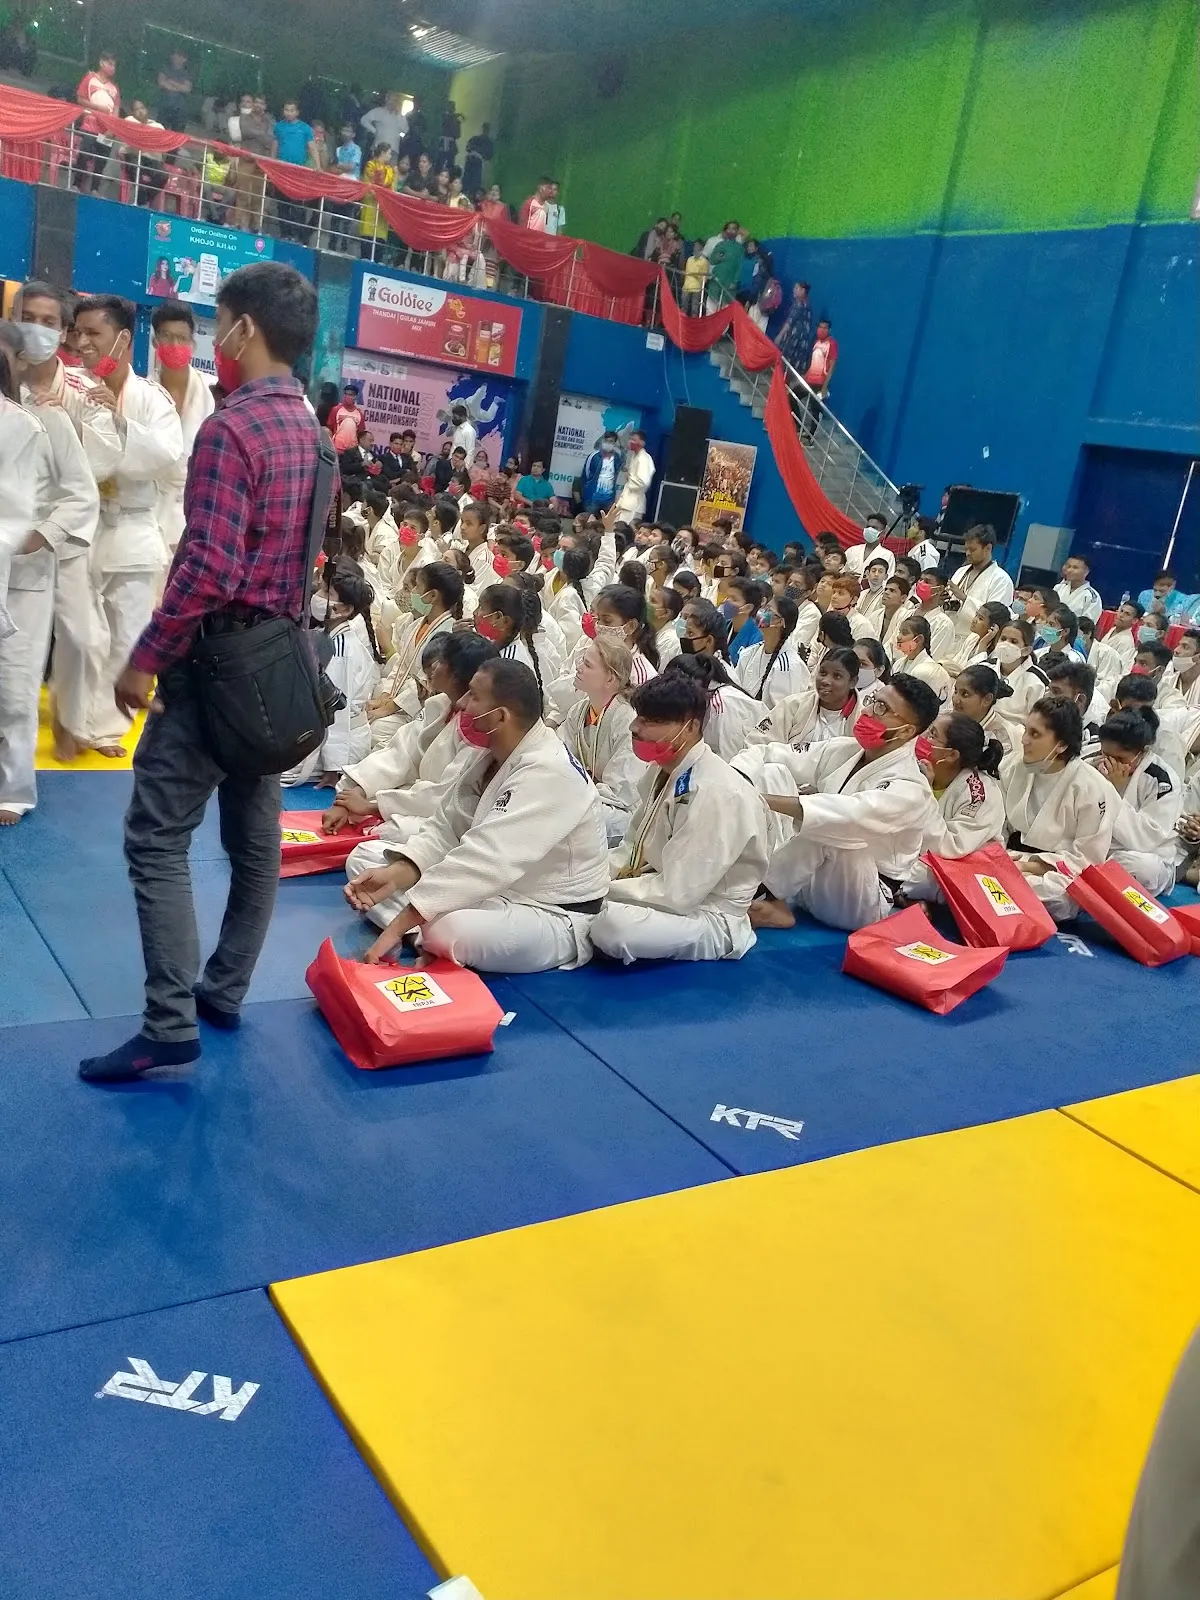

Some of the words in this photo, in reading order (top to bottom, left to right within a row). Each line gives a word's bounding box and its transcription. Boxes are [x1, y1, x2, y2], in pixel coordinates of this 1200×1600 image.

[189, 236, 215, 247] KHOJO
[377, 286, 433, 312] Goldiee
[372, 308, 397, 320] THANDAI
[399, 314, 417, 324] GULAB
[417, 319, 437, 328] JAMUN
[411, 324, 422, 332] MIX
[191, 357, 216, 371] IONAL
[368, 382, 420, 406] NATIONAL
[366, 399, 388, 412] BLIND
[388, 403, 403, 414] AND
[403, 405, 420, 417] DEAF
[363, 409, 418, 428] CHAMPIONSHIPS
[557, 425, 586, 439] NATIONAL
[549, 472, 573, 483] RONG
[709, 1103, 803, 1141] KTR
[102, 1356, 261, 1421] KTR
